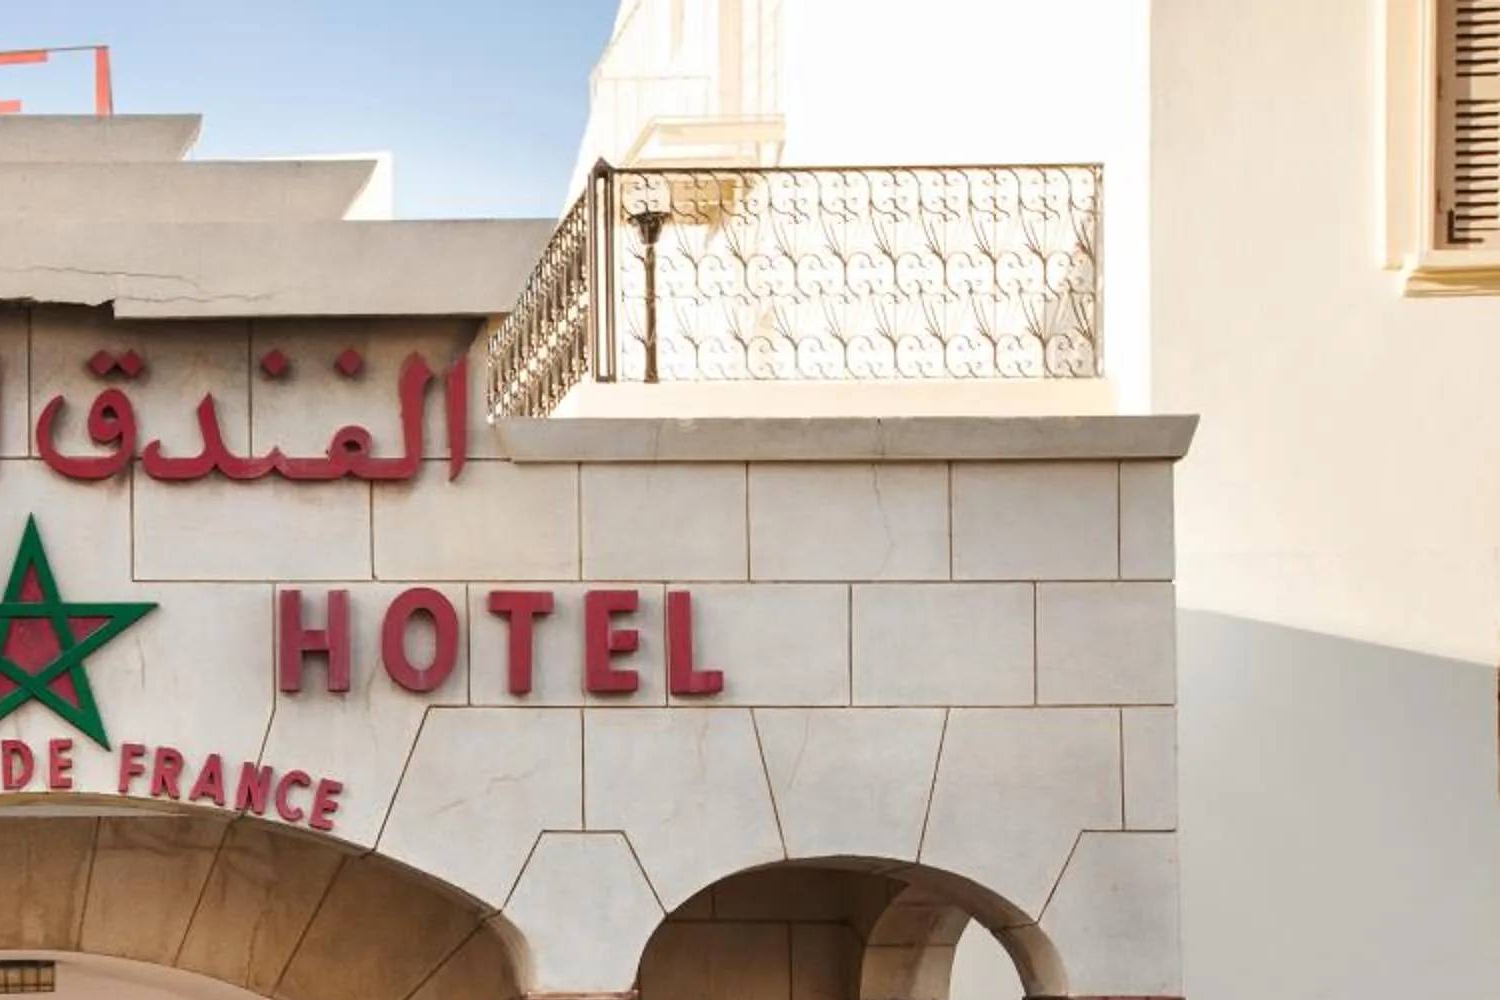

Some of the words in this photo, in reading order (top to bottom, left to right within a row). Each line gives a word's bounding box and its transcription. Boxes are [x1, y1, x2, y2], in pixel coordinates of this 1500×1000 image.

[37, 348, 467, 483] الفندق
[278, 586, 724, 695] HOTEL
[0, 738, 73, 790] DE
[117, 743, 343, 831] FRANCE
